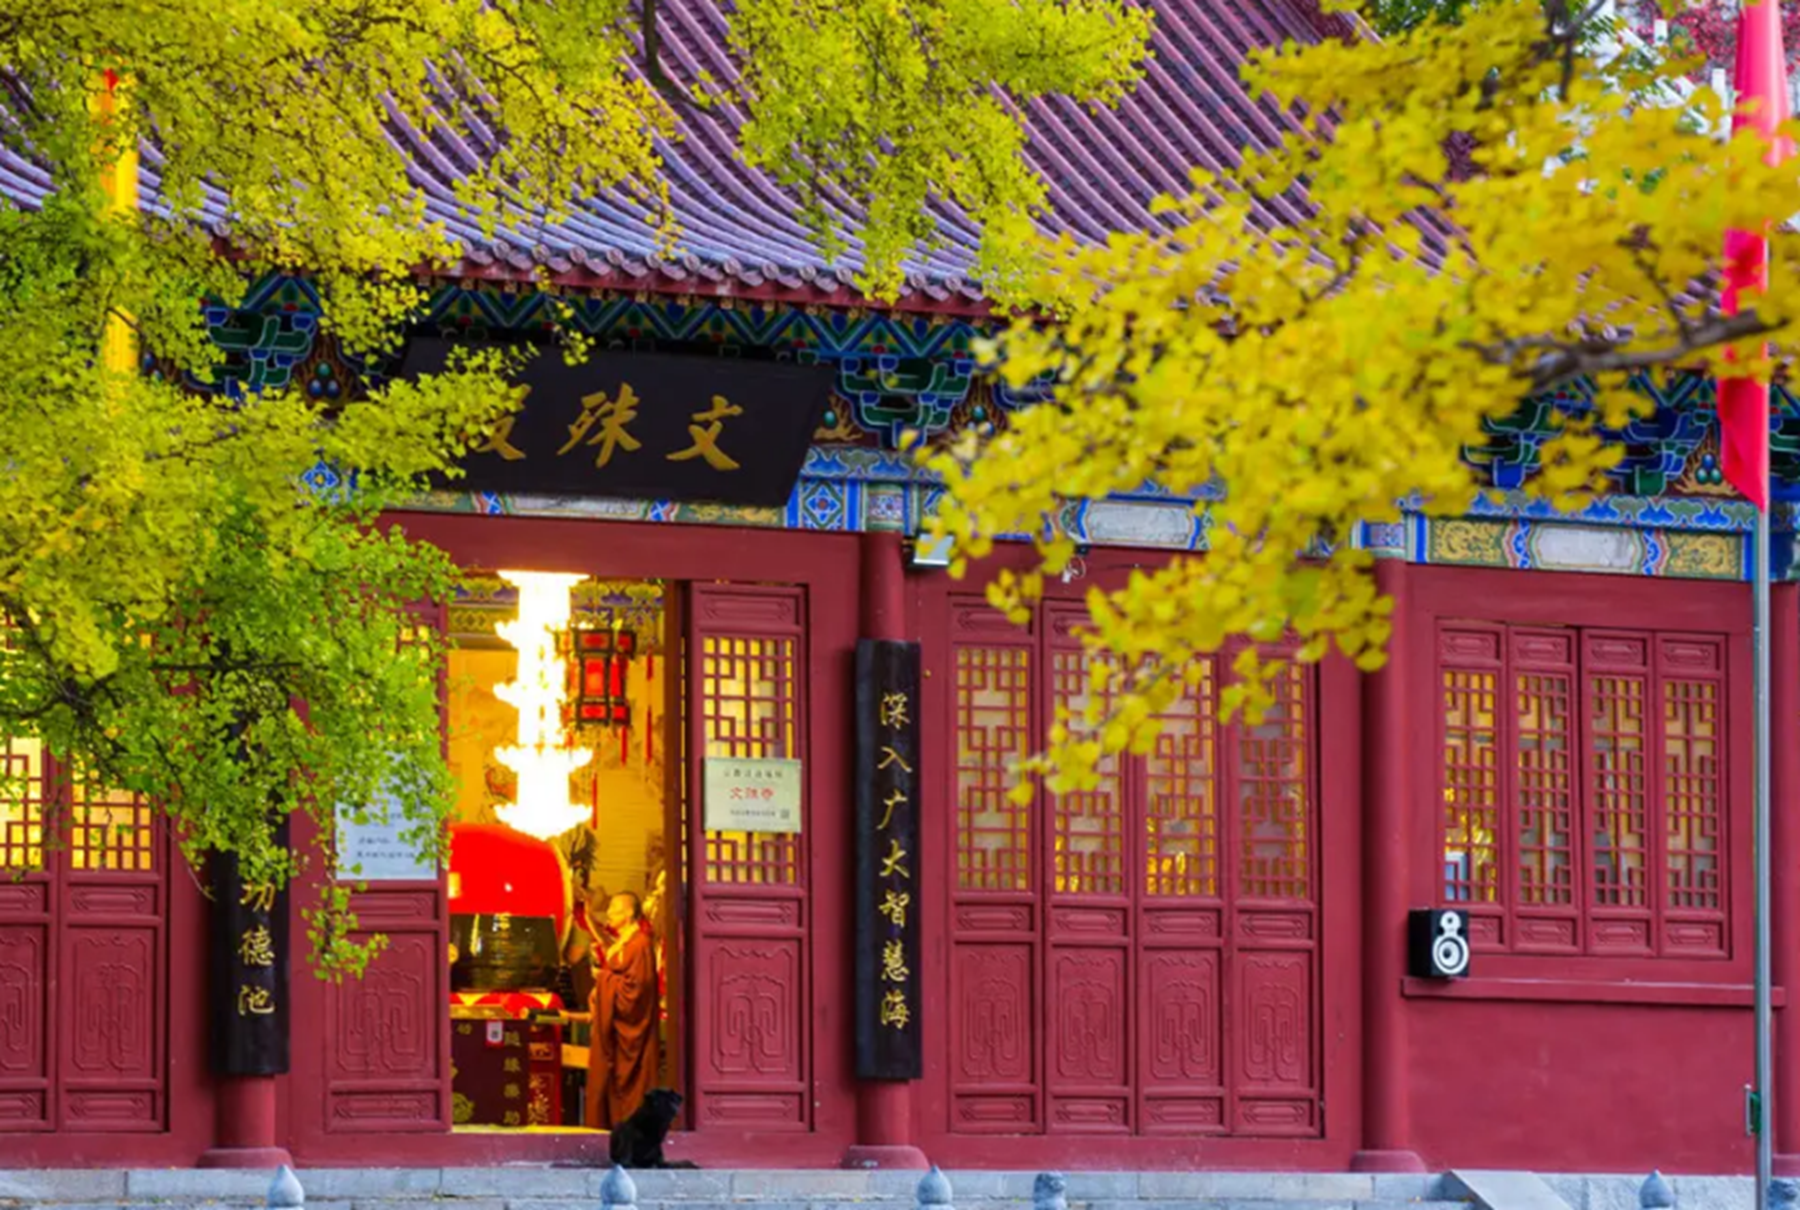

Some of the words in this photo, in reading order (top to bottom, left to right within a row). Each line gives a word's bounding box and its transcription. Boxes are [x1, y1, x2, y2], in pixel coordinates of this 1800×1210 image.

[238, 881, 276, 1016] 功德池
[877, 692, 913, 1030] 深入广大智慧海
